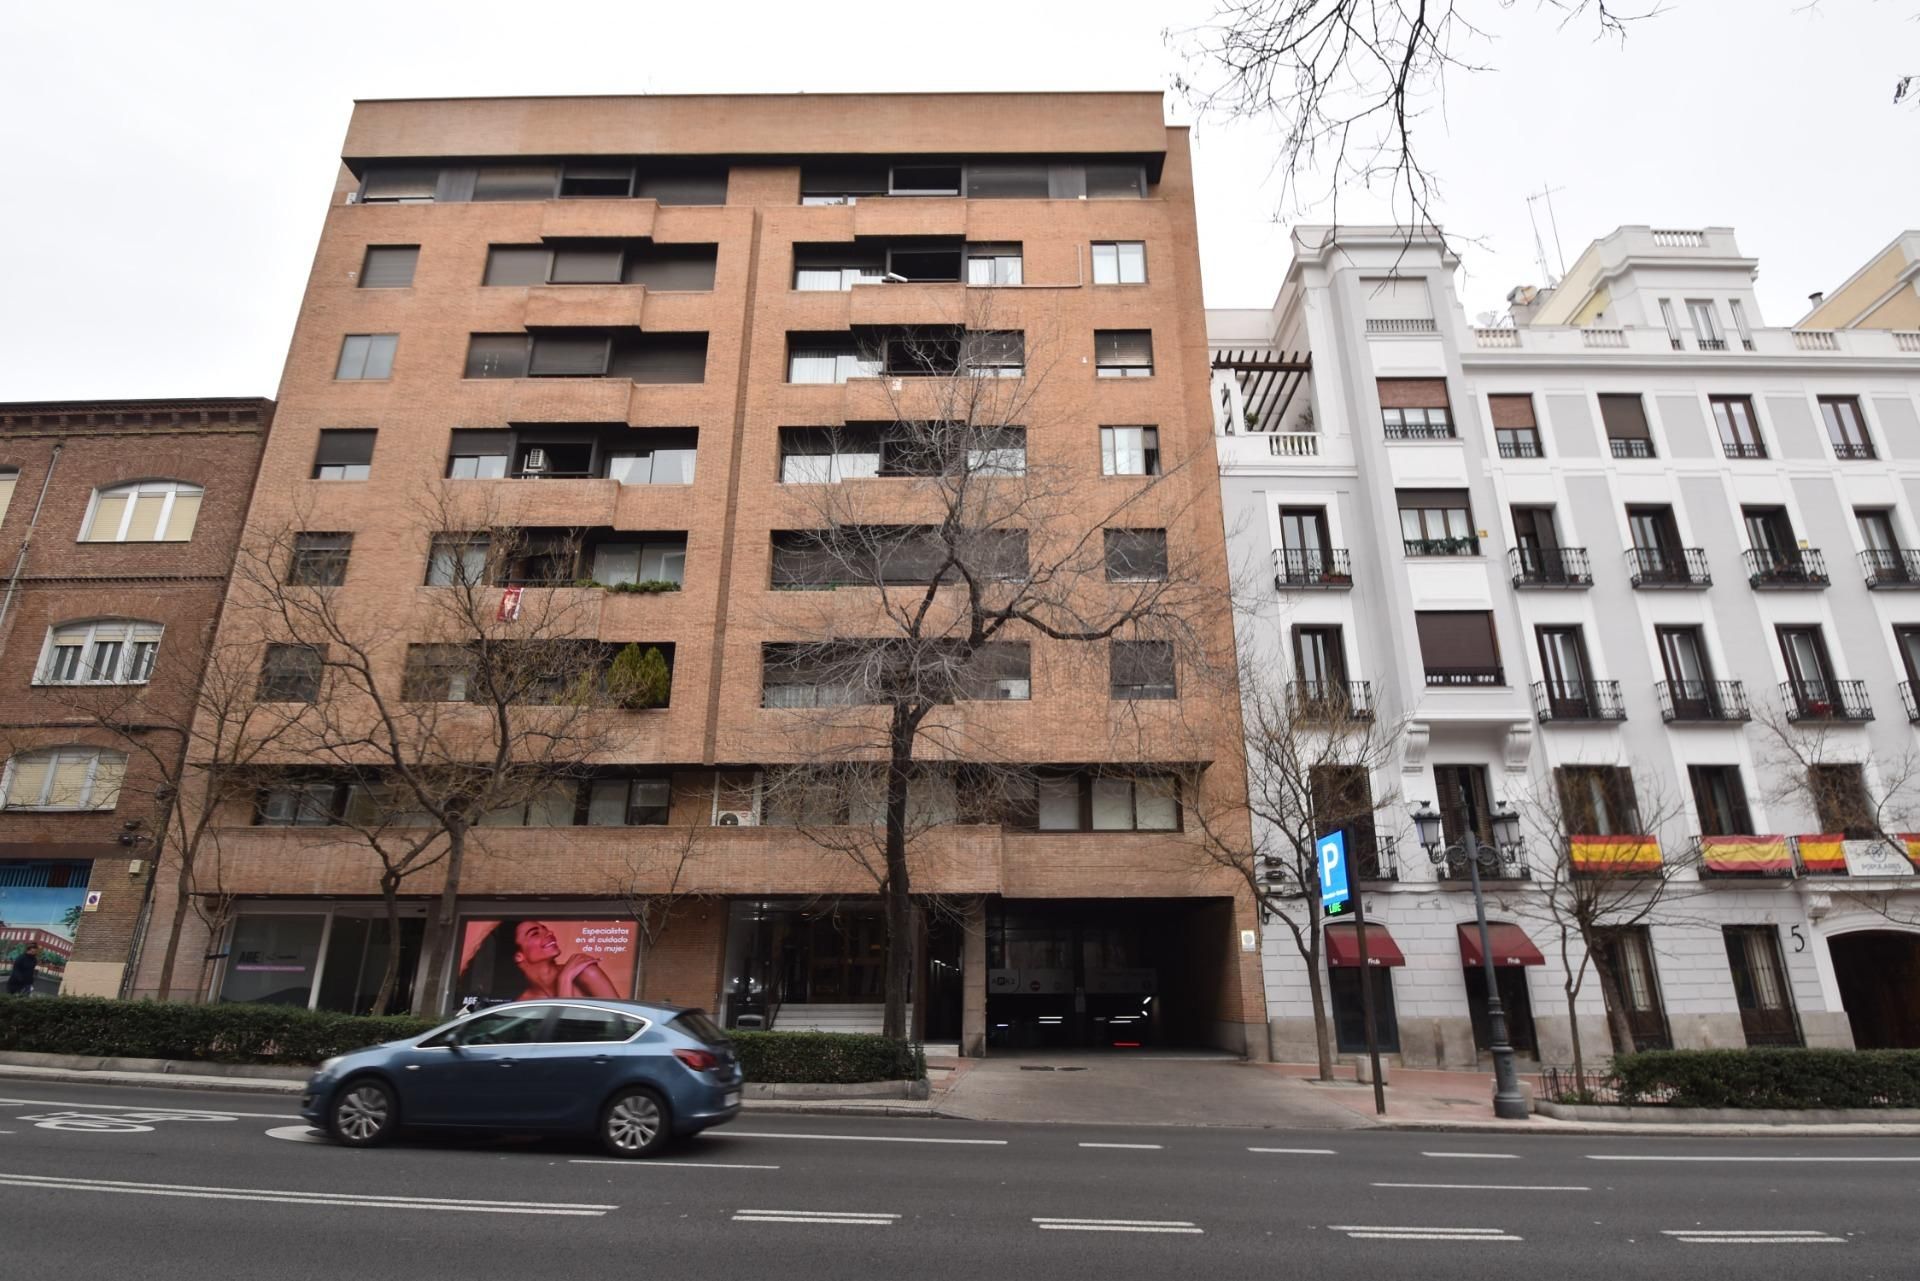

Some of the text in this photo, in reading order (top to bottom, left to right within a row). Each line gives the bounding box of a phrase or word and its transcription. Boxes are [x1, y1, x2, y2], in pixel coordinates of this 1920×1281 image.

[1322, 842, 1339, 888] P
[582, 928, 629, 936] Especialistas
[1791, 924, 1805, 953] 5
